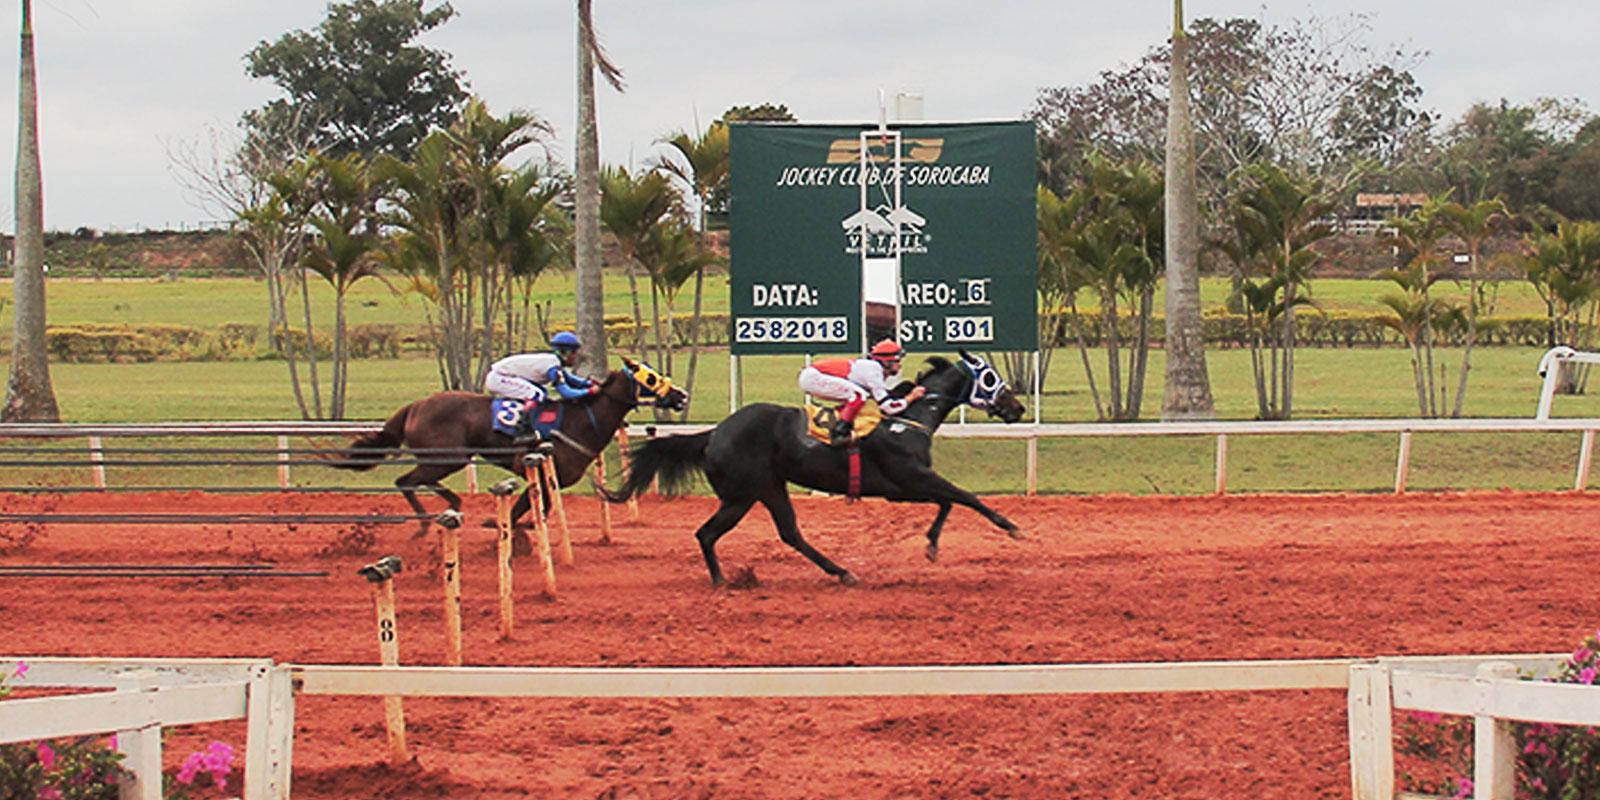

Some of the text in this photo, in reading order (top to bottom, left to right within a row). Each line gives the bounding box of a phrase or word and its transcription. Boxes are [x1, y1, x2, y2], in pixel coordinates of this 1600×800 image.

[777, 167, 838, 186] JOCKEY
[839, 167, 881, 185] CLUB
[907, 166, 990, 185] SOROCABA
[753, 284, 818, 306] DATA:
[970, 284, 983, 301] 6
[738, 320, 845, 338] 2582018
[949, 320, 990, 338] 301
[497, 400, 524, 426] 3
[380, 618, 394, 643] 8
